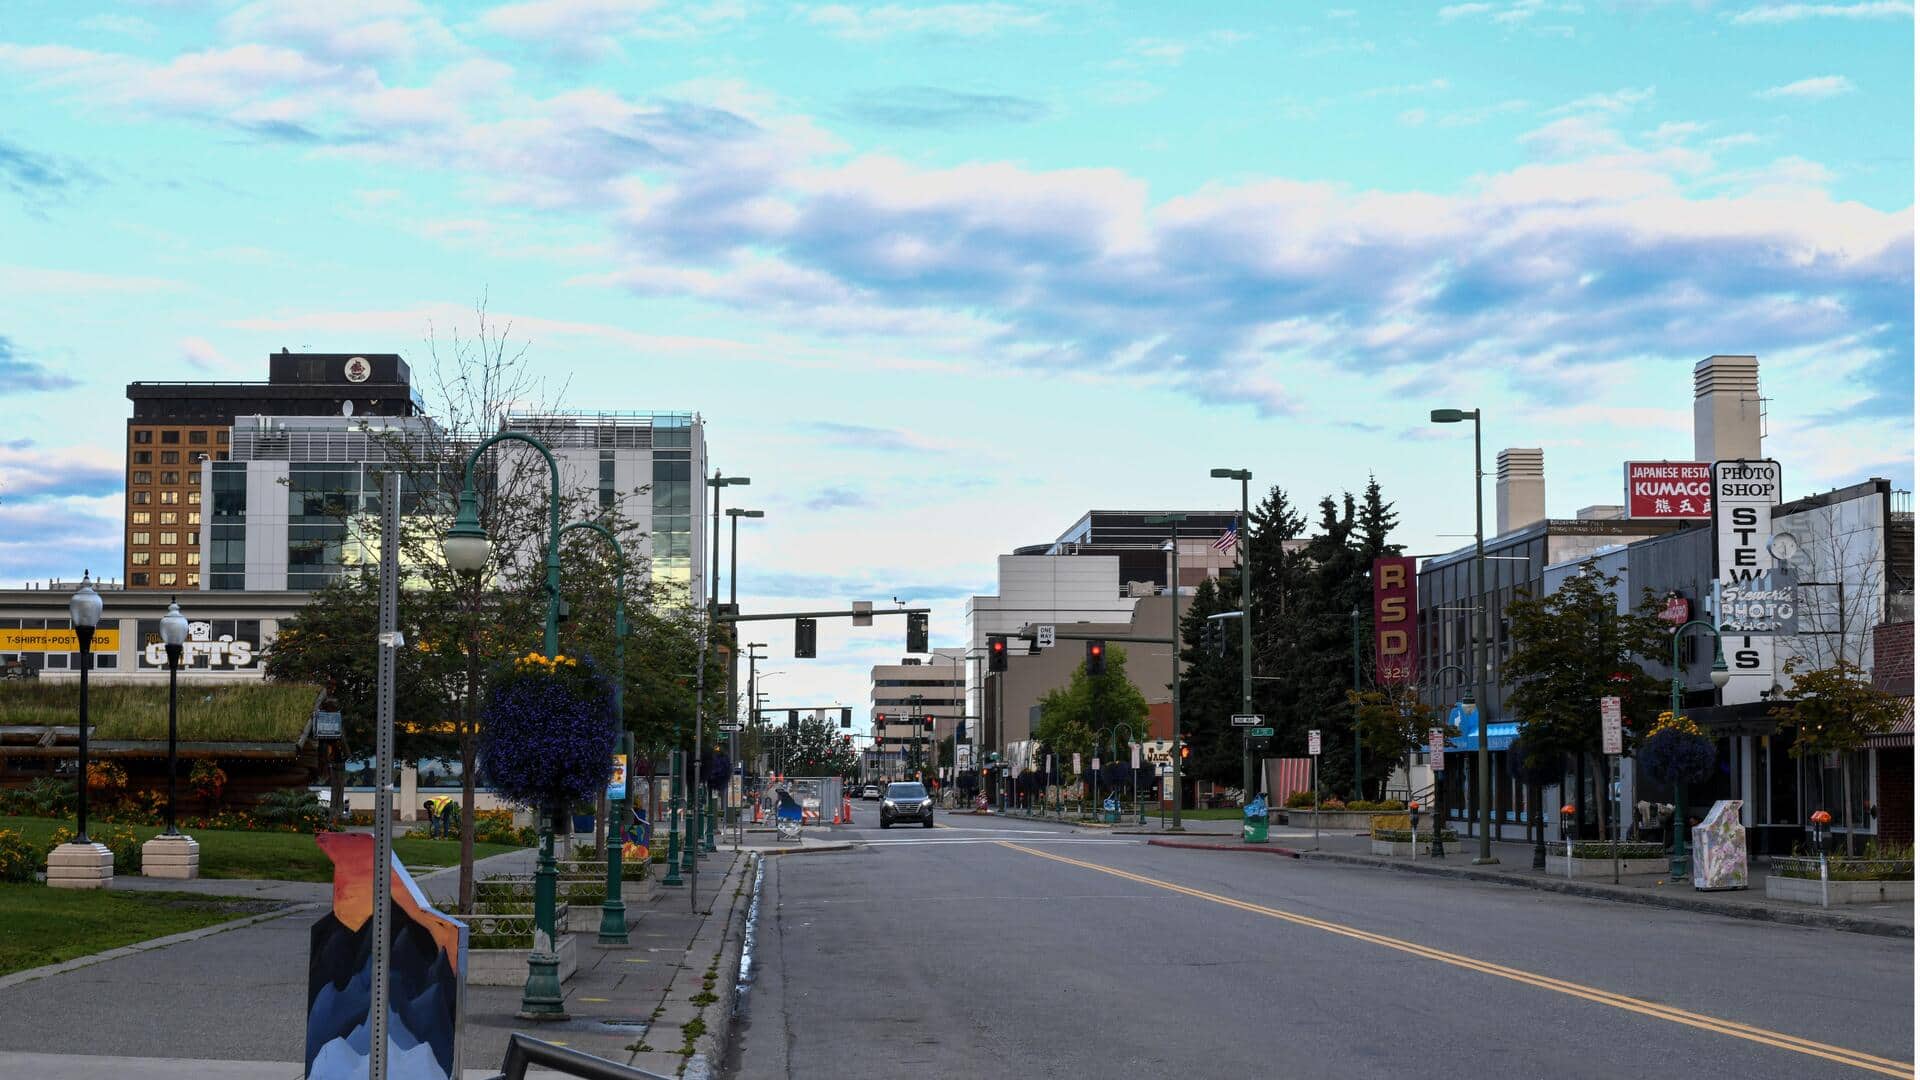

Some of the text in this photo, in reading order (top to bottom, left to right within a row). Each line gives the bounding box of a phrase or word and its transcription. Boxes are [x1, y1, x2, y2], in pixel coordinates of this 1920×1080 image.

[1632, 466, 1679, 479] JAPANESE
[1721, 466, 1775, 480] PHOTO
[1721, 483, 1775, 497] SHOP
[1380, 564, 1408, 655] RSD
[1721, 603, 1794, 619] PHOTO
[52, 636, 110, 644] POSTRDS
[145, 640, 252, 665] GFTS
[1383, 667, 1410, 679] 325
